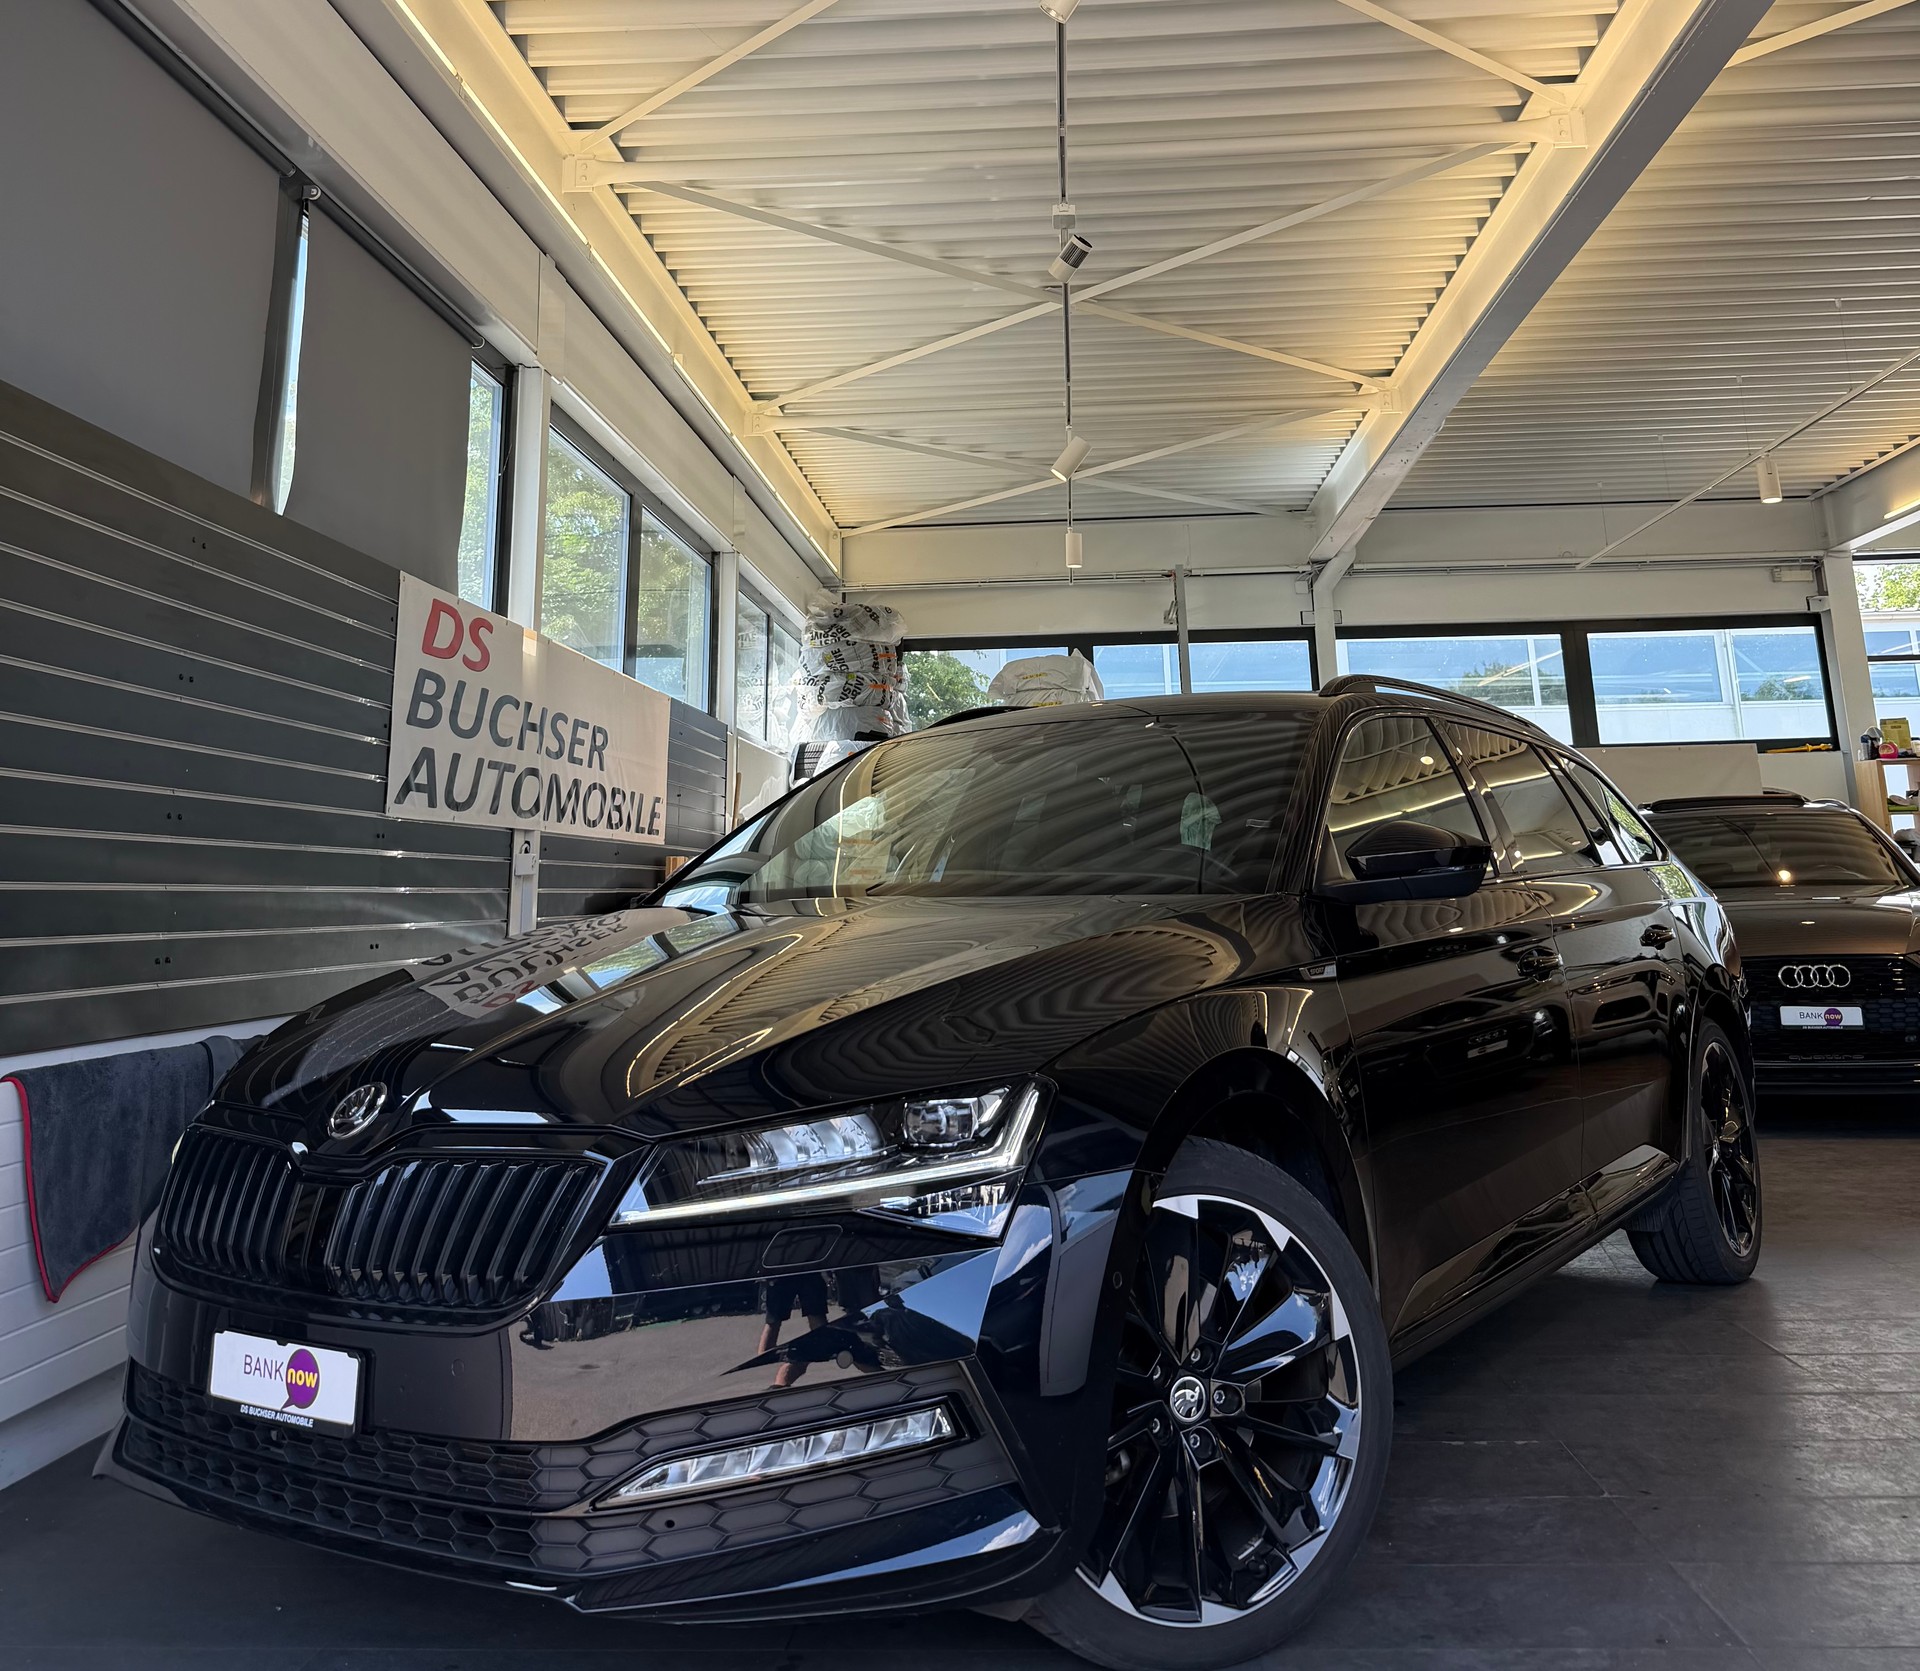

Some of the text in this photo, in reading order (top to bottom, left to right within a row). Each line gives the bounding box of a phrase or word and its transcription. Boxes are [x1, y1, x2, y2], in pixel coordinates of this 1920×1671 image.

[421, 598, 494, 672] DS
[406, 668, 610, 772] BUCHSER
[394, 747, 662, 836] AUTOMOBILE
[1799, 1011, 1823, 1020] BANK
[243, 1353, 318, 1389] BANK now
[240, 1404, 315, 1428] DS BUCHSER AUTOMOBILE
